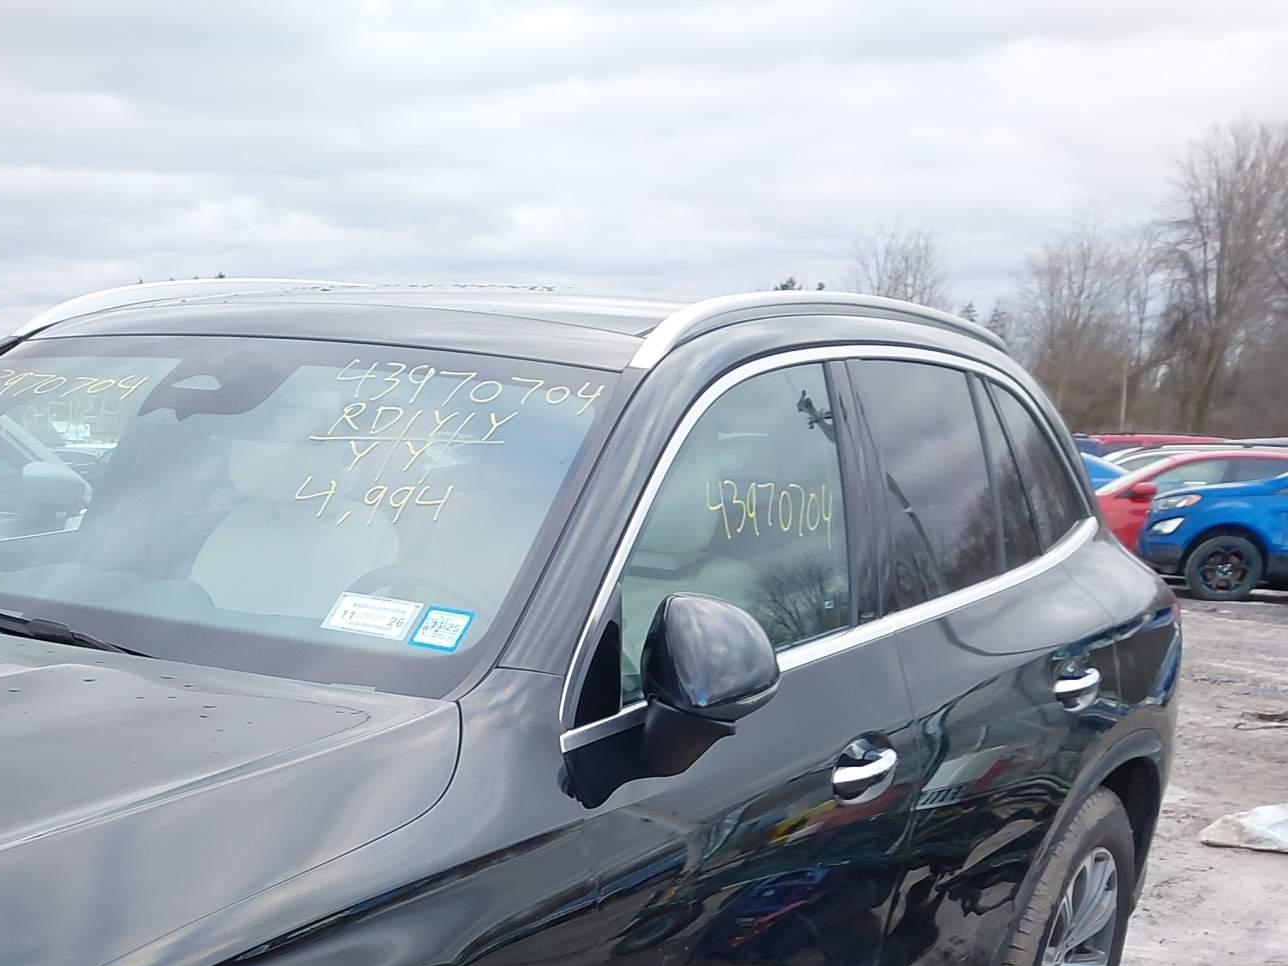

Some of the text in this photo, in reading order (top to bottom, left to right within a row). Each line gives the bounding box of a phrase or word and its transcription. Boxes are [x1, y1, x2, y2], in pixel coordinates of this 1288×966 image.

[336, 358, 605, 416] 43970704
[294, 476, 454, 525] 4,994
[706, 479, 833, 550] 43970704
